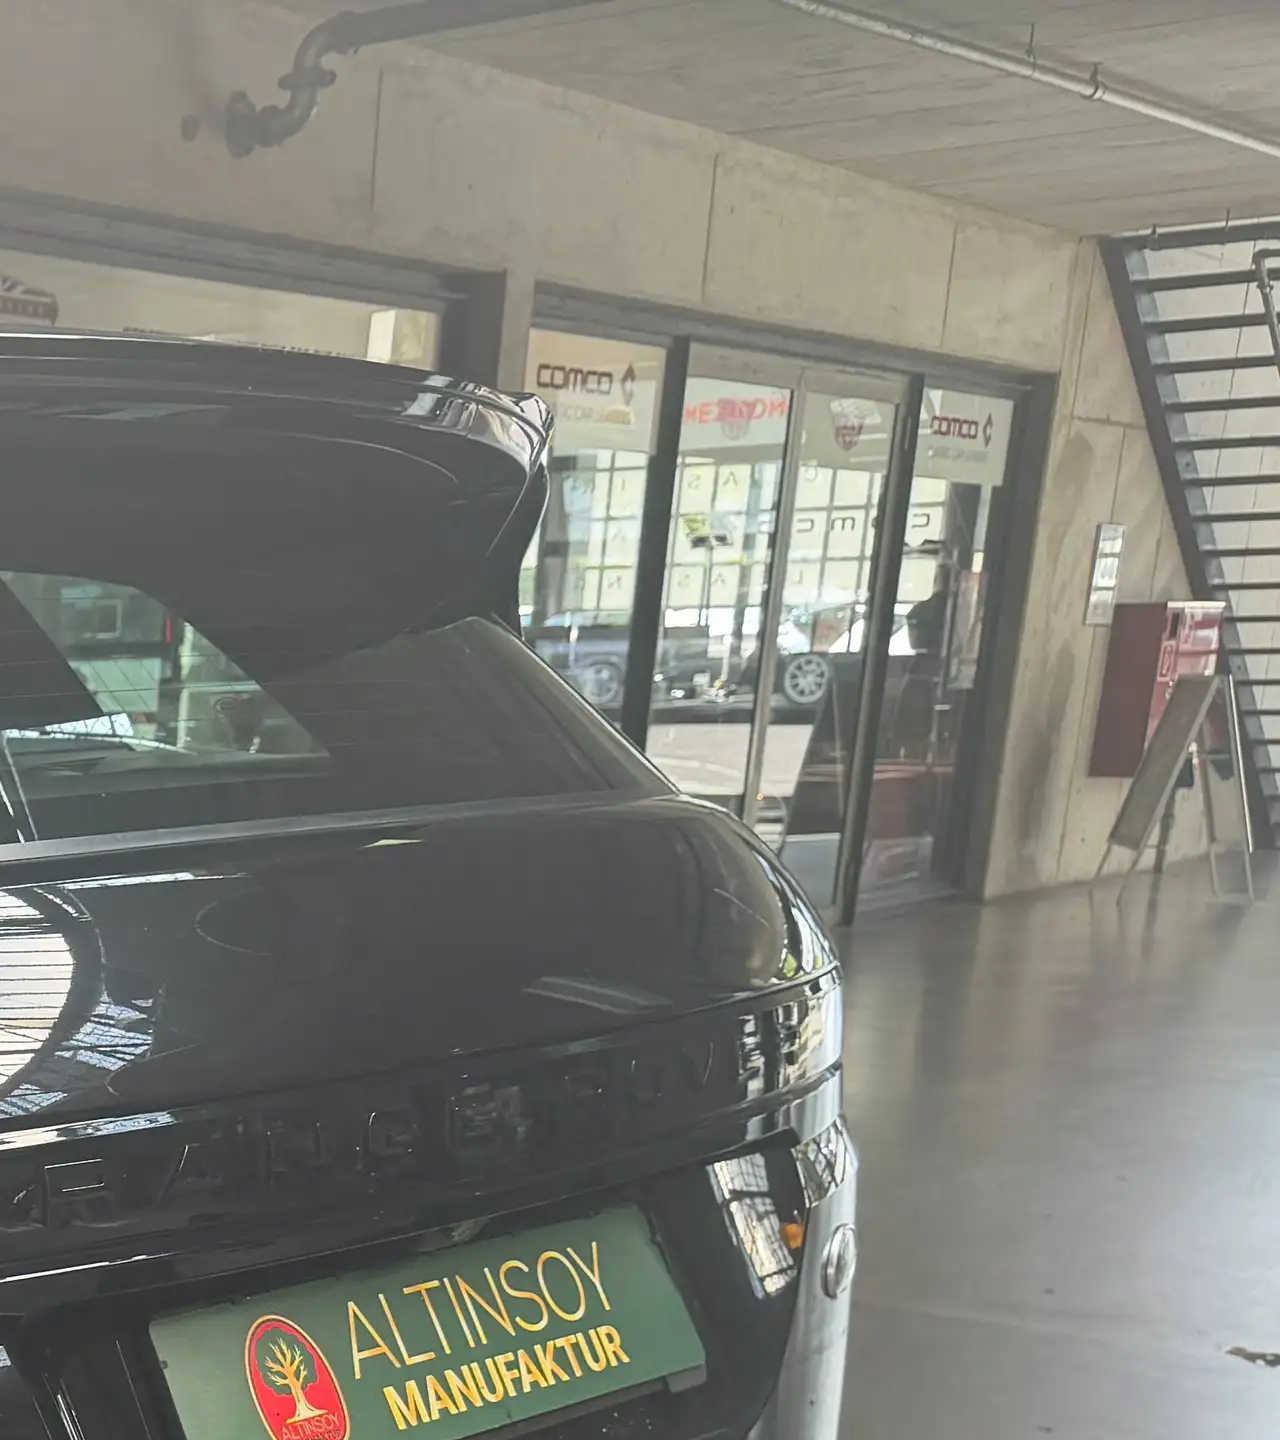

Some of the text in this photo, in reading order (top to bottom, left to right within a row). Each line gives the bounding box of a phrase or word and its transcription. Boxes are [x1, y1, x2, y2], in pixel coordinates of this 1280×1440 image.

[346, 1240, 613, 1380] ALTINSOY
[281, 1411, 339, 1440] ALTINSOY
[383, 1324, 631, 1431] MANUFAKTUR
